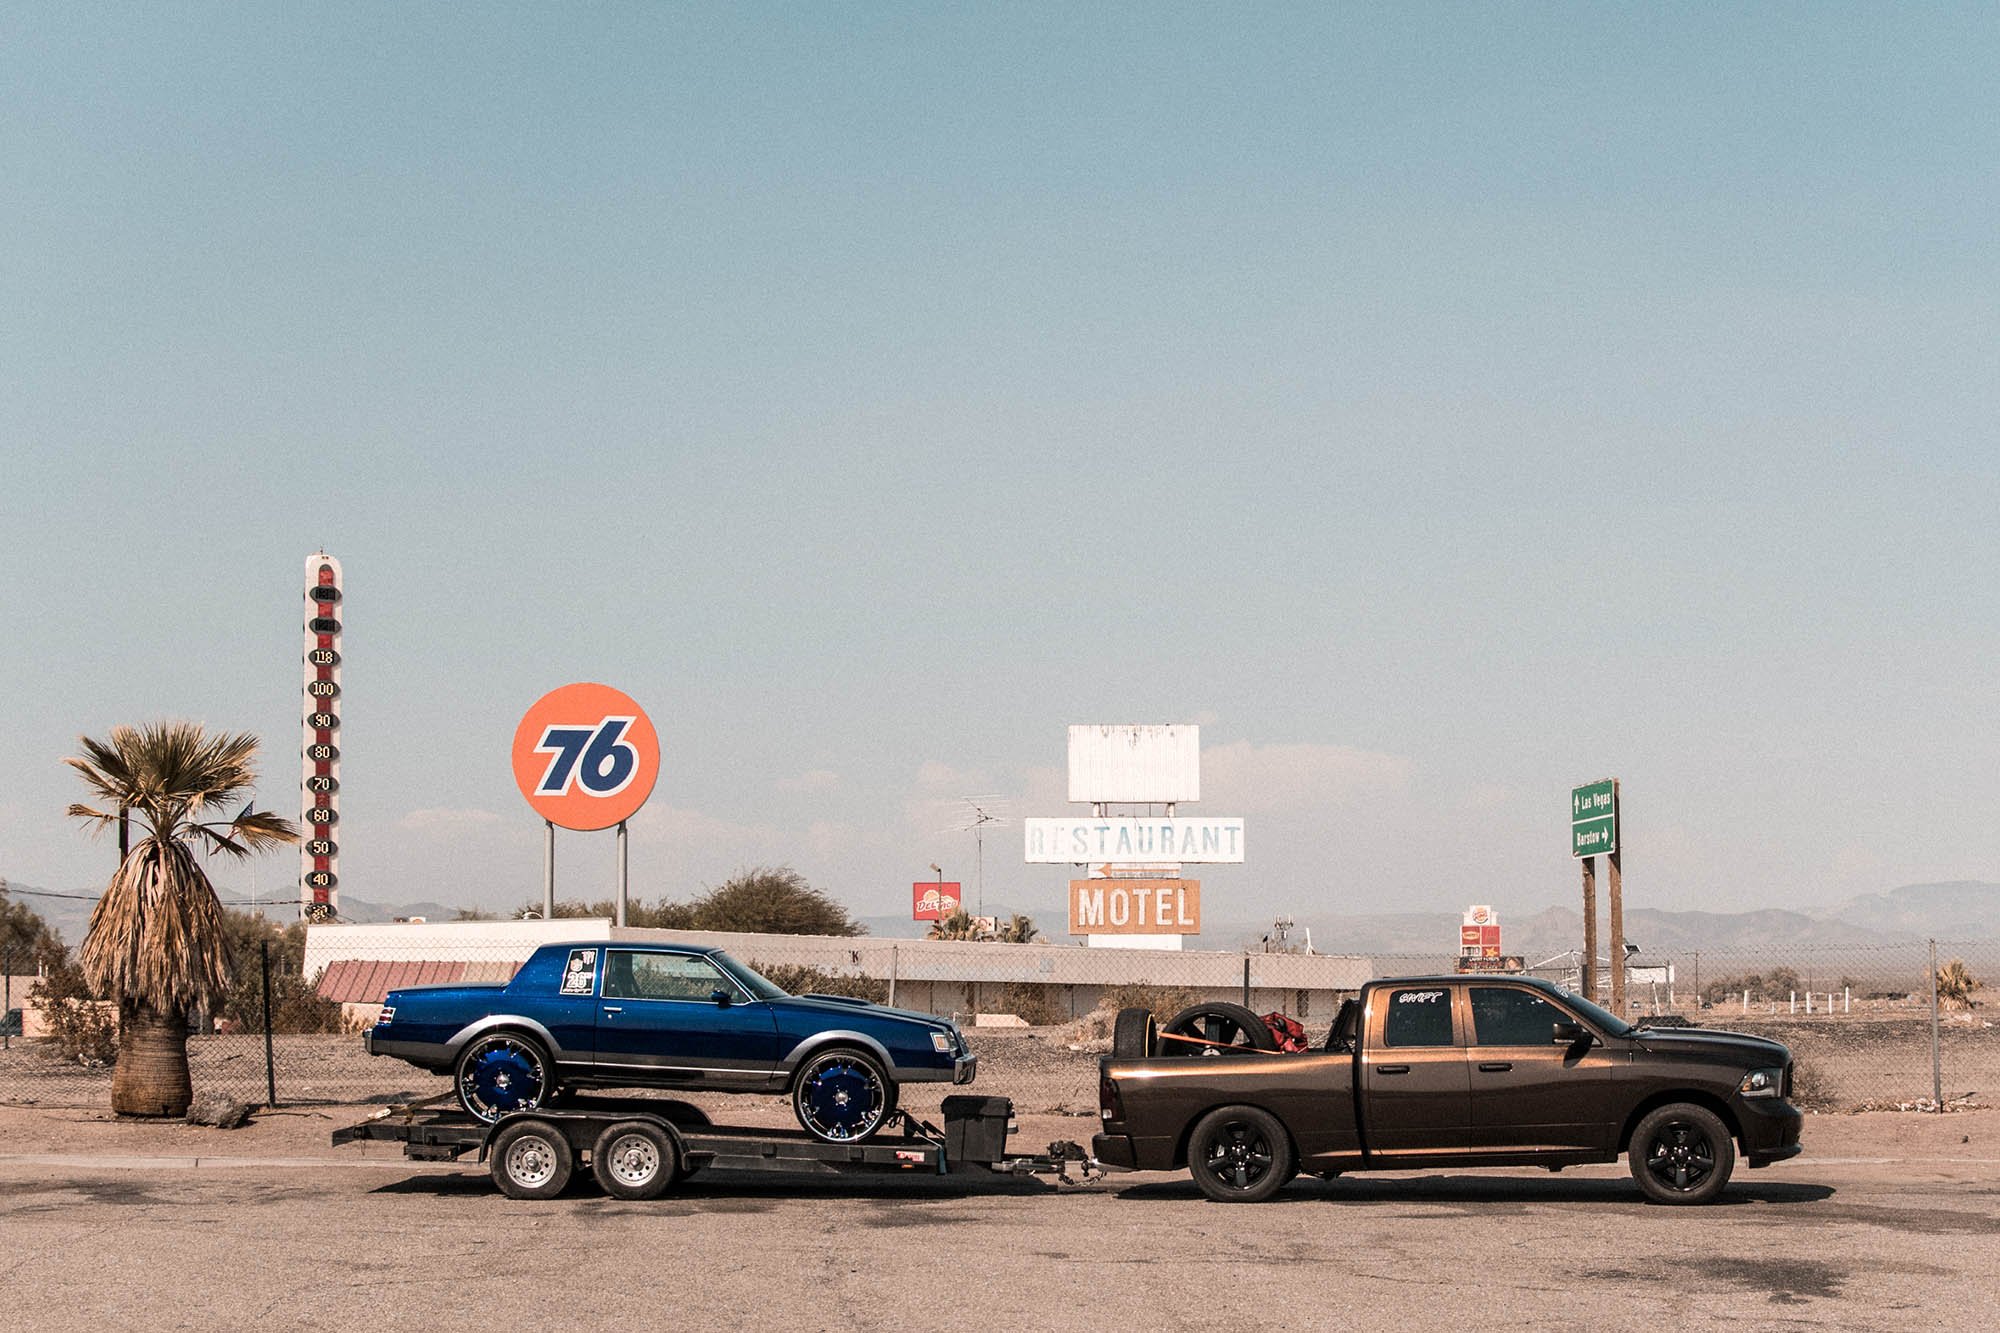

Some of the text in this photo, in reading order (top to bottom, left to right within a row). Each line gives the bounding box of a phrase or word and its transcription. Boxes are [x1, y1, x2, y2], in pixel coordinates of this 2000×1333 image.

[315, 651, 333, 663] 118
[313, 682, 333, 695] 100
[315, 714, 331, 726] 90
[314, 746, 330, 758] 80
[533, 716, 640, 798] 76
[314, 778, 329, 790] 70
[1581, 793, 1611, 810] Las Vegas
[314, 810, 329, 822] 60
[1577, 831, 1600, 847] Barstow
[313, 841, 328, 854] 50
[312, 874, 328, 886] 40
[1078, 888, 1195, 926] MOTEL
[852, 950, 859, 963] K
